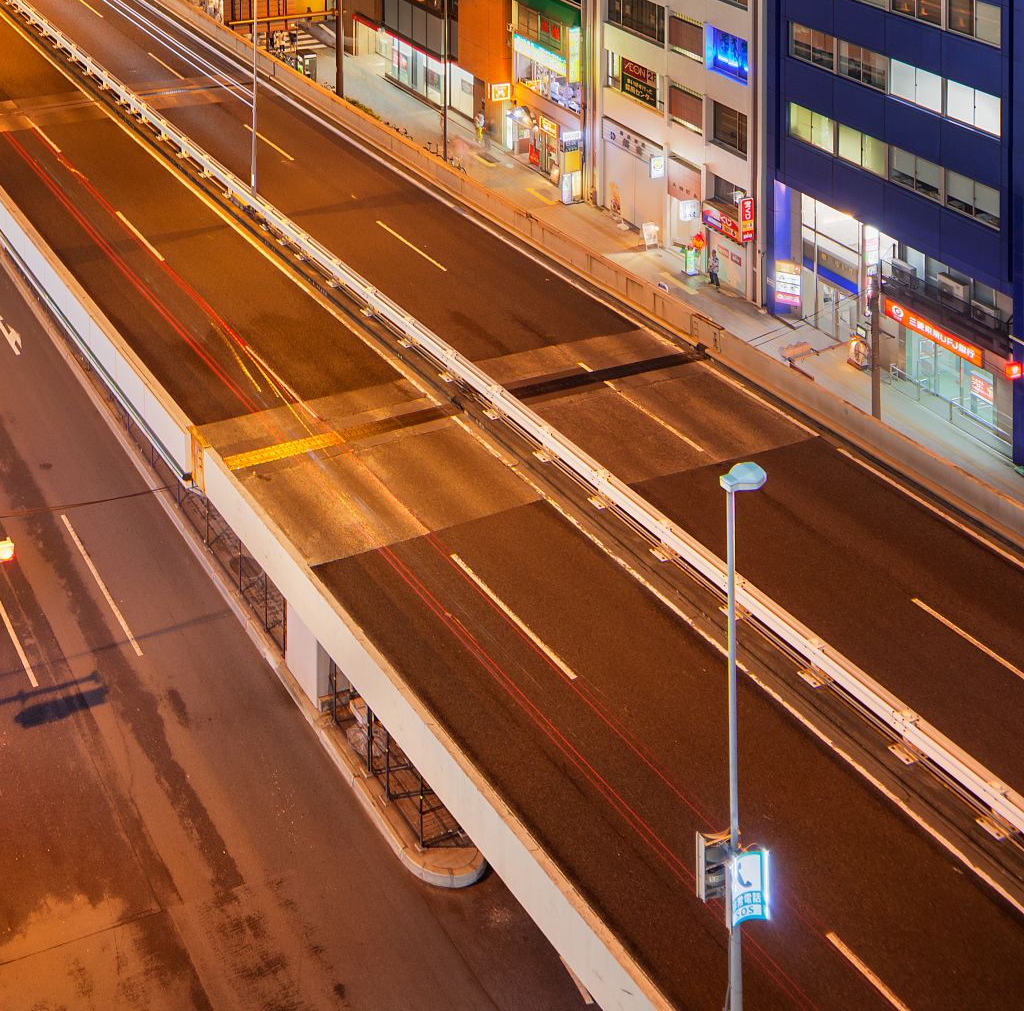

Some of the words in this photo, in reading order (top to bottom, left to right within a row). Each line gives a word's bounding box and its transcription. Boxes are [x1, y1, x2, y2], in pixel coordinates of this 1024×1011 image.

[540, 20, 561, 41] 麻雀
[908, 316, 976, 359] 三菱東京UFJ銀行
[735, 905, 755, 919] SOS
